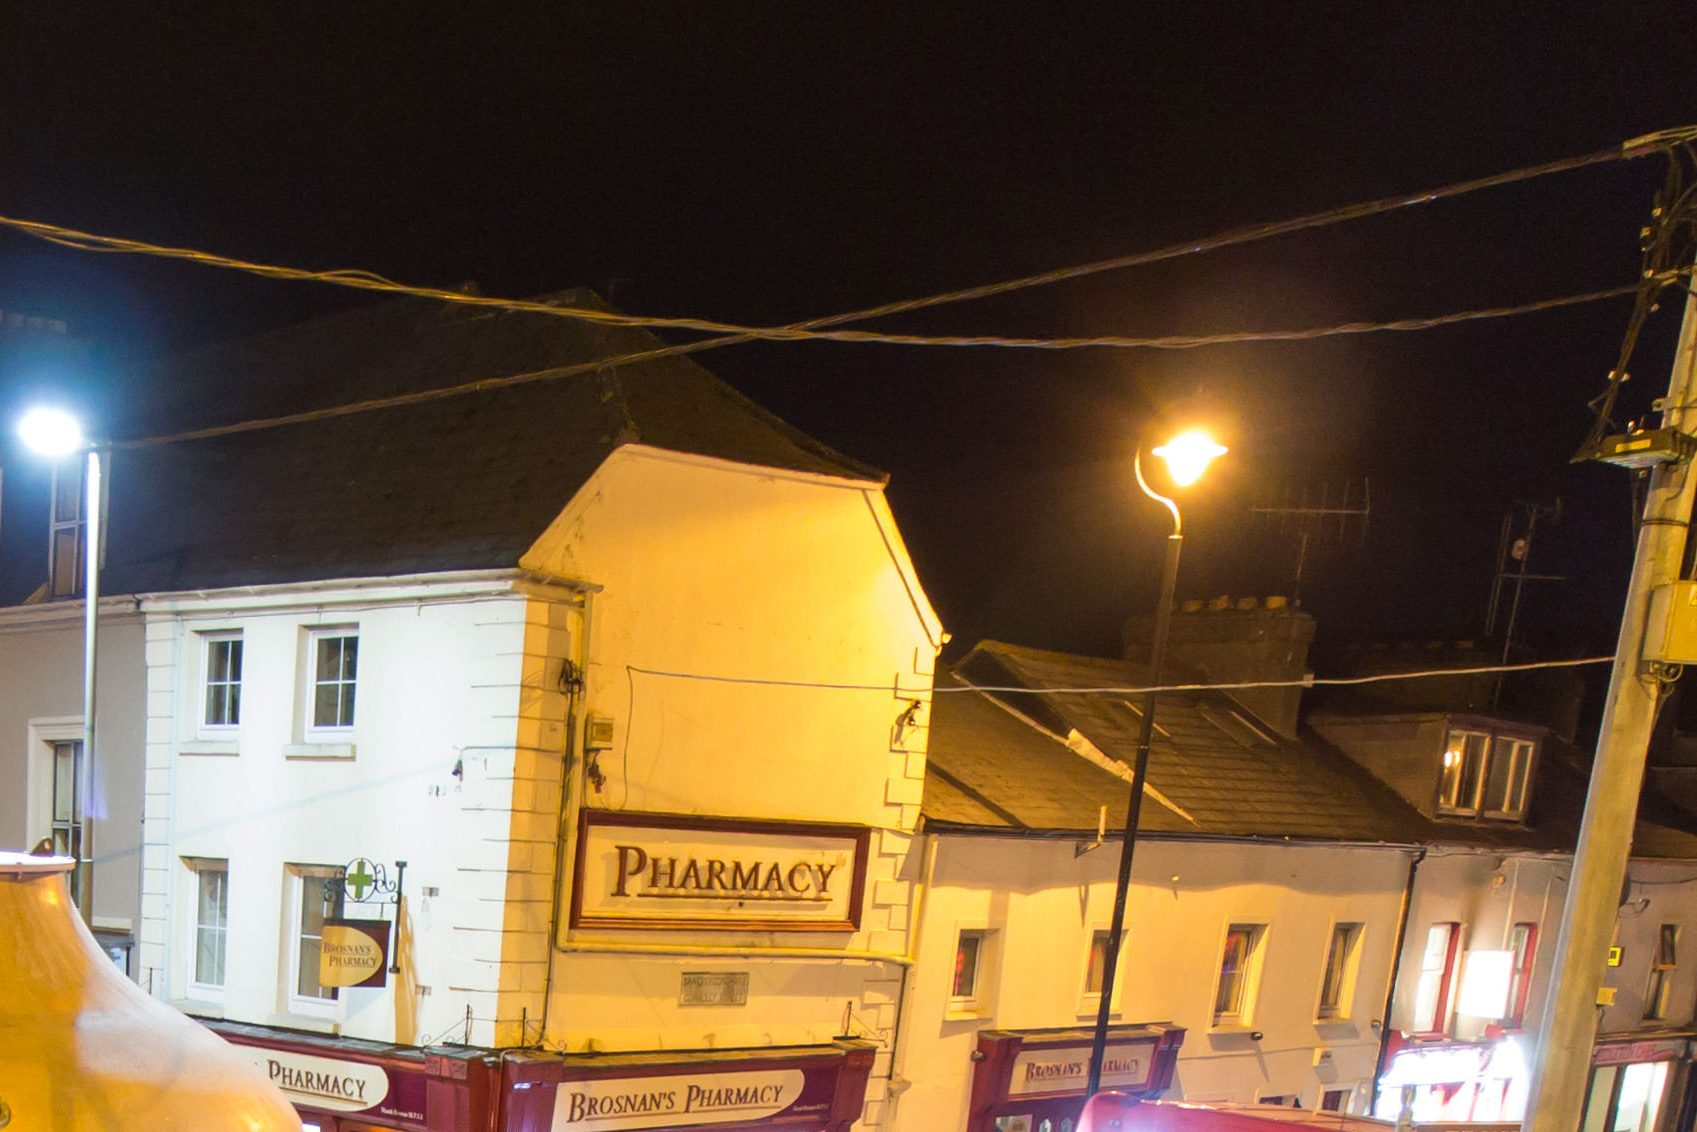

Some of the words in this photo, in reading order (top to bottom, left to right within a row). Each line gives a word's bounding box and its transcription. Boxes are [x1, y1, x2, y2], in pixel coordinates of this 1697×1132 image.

[610, 845, 836, 897] PHARMACY
[328, 955, 376, 968] PHARMACY
[266, 1059, 367, 1098] PHARMACY
[565, 1090, 677, 1123] BROSNAN'S
[683, 1084, 784, 1114] PHARMACY
